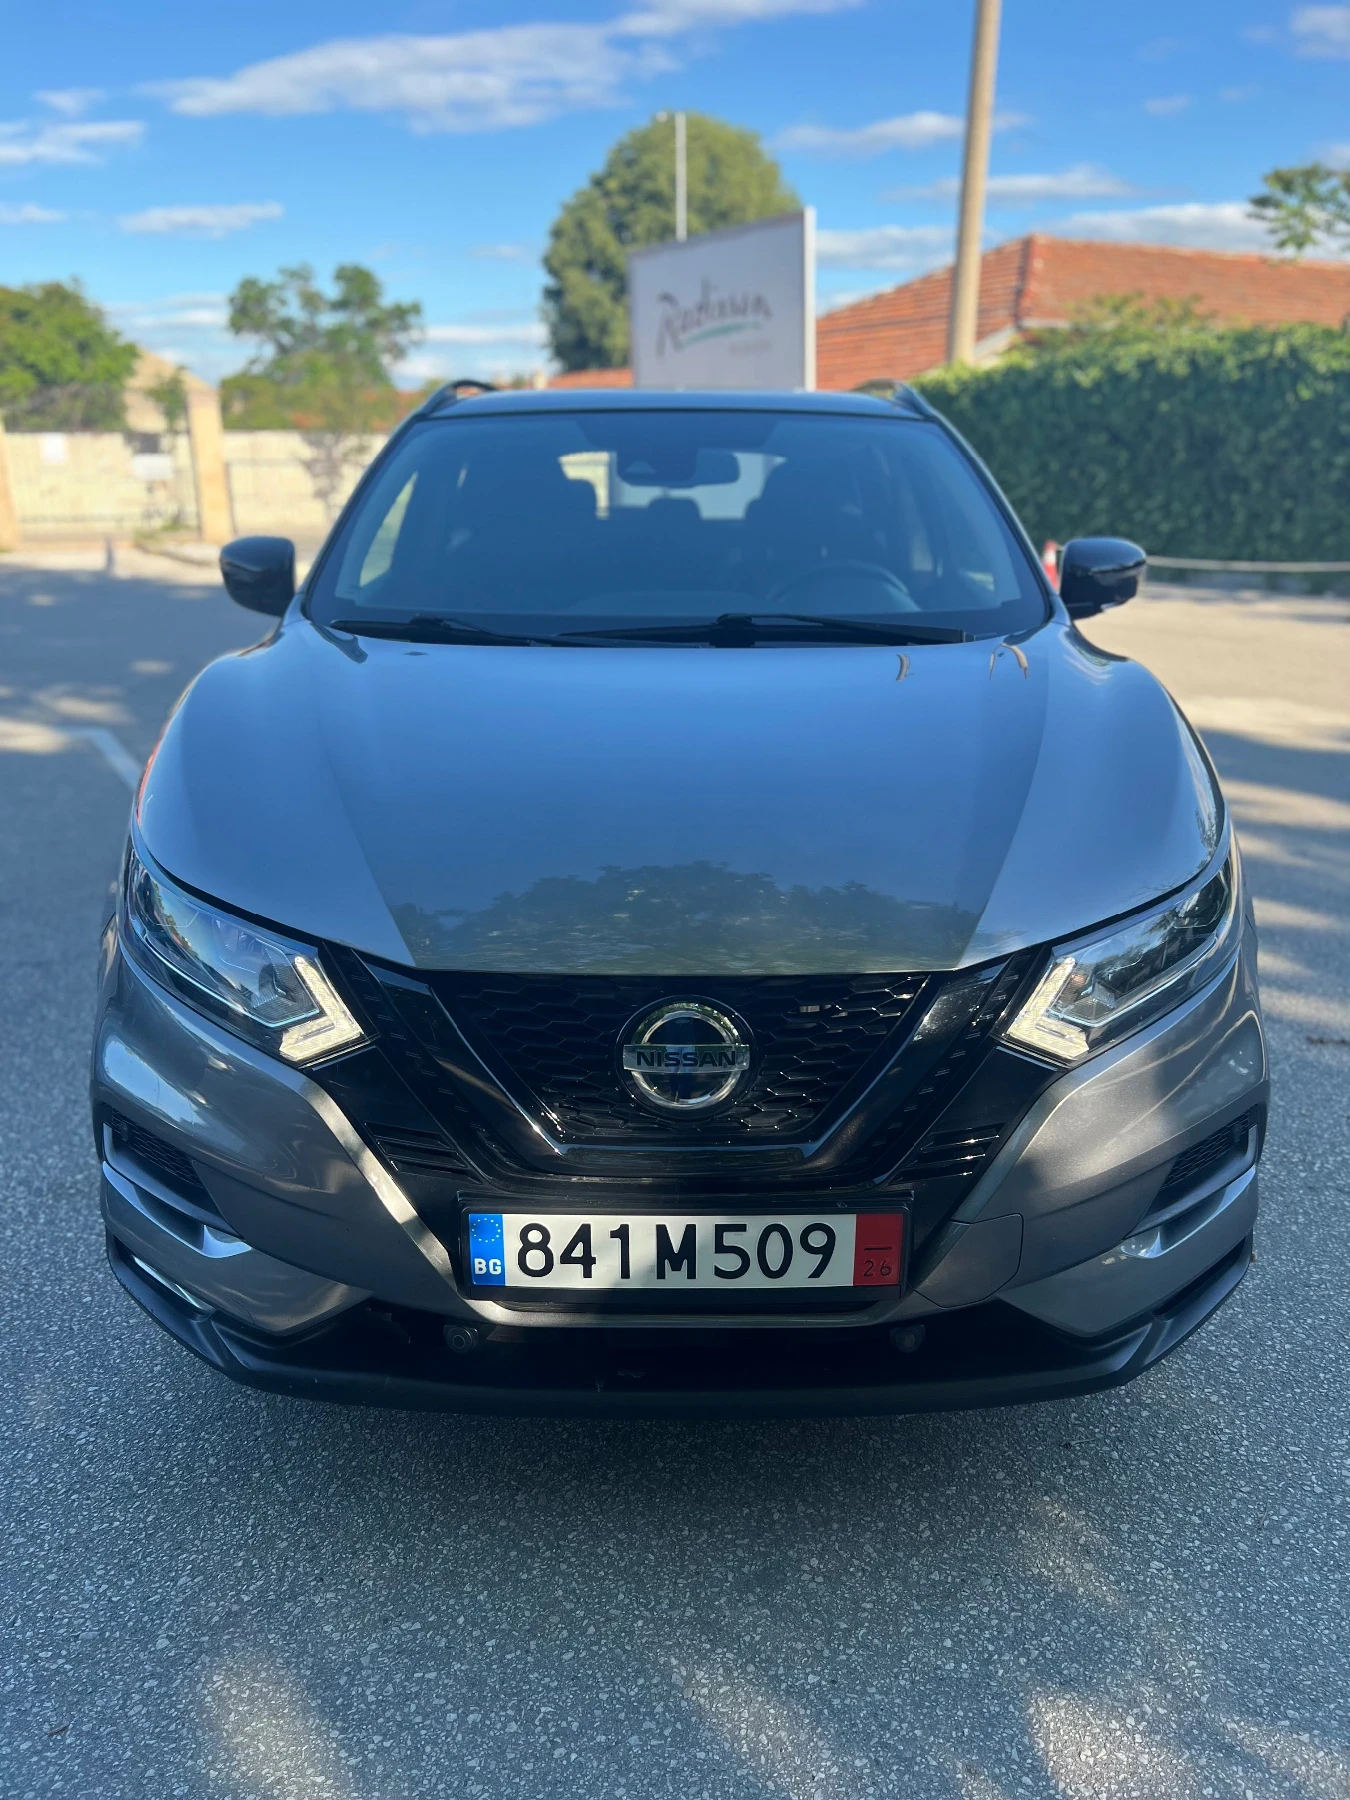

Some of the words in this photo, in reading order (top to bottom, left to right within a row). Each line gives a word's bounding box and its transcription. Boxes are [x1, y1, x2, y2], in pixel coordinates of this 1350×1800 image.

[636, 1050, 736, 1068] NISSAN
[474, 1258, 502, 1275] BG
[863, 1259, 892, 1277] 26
